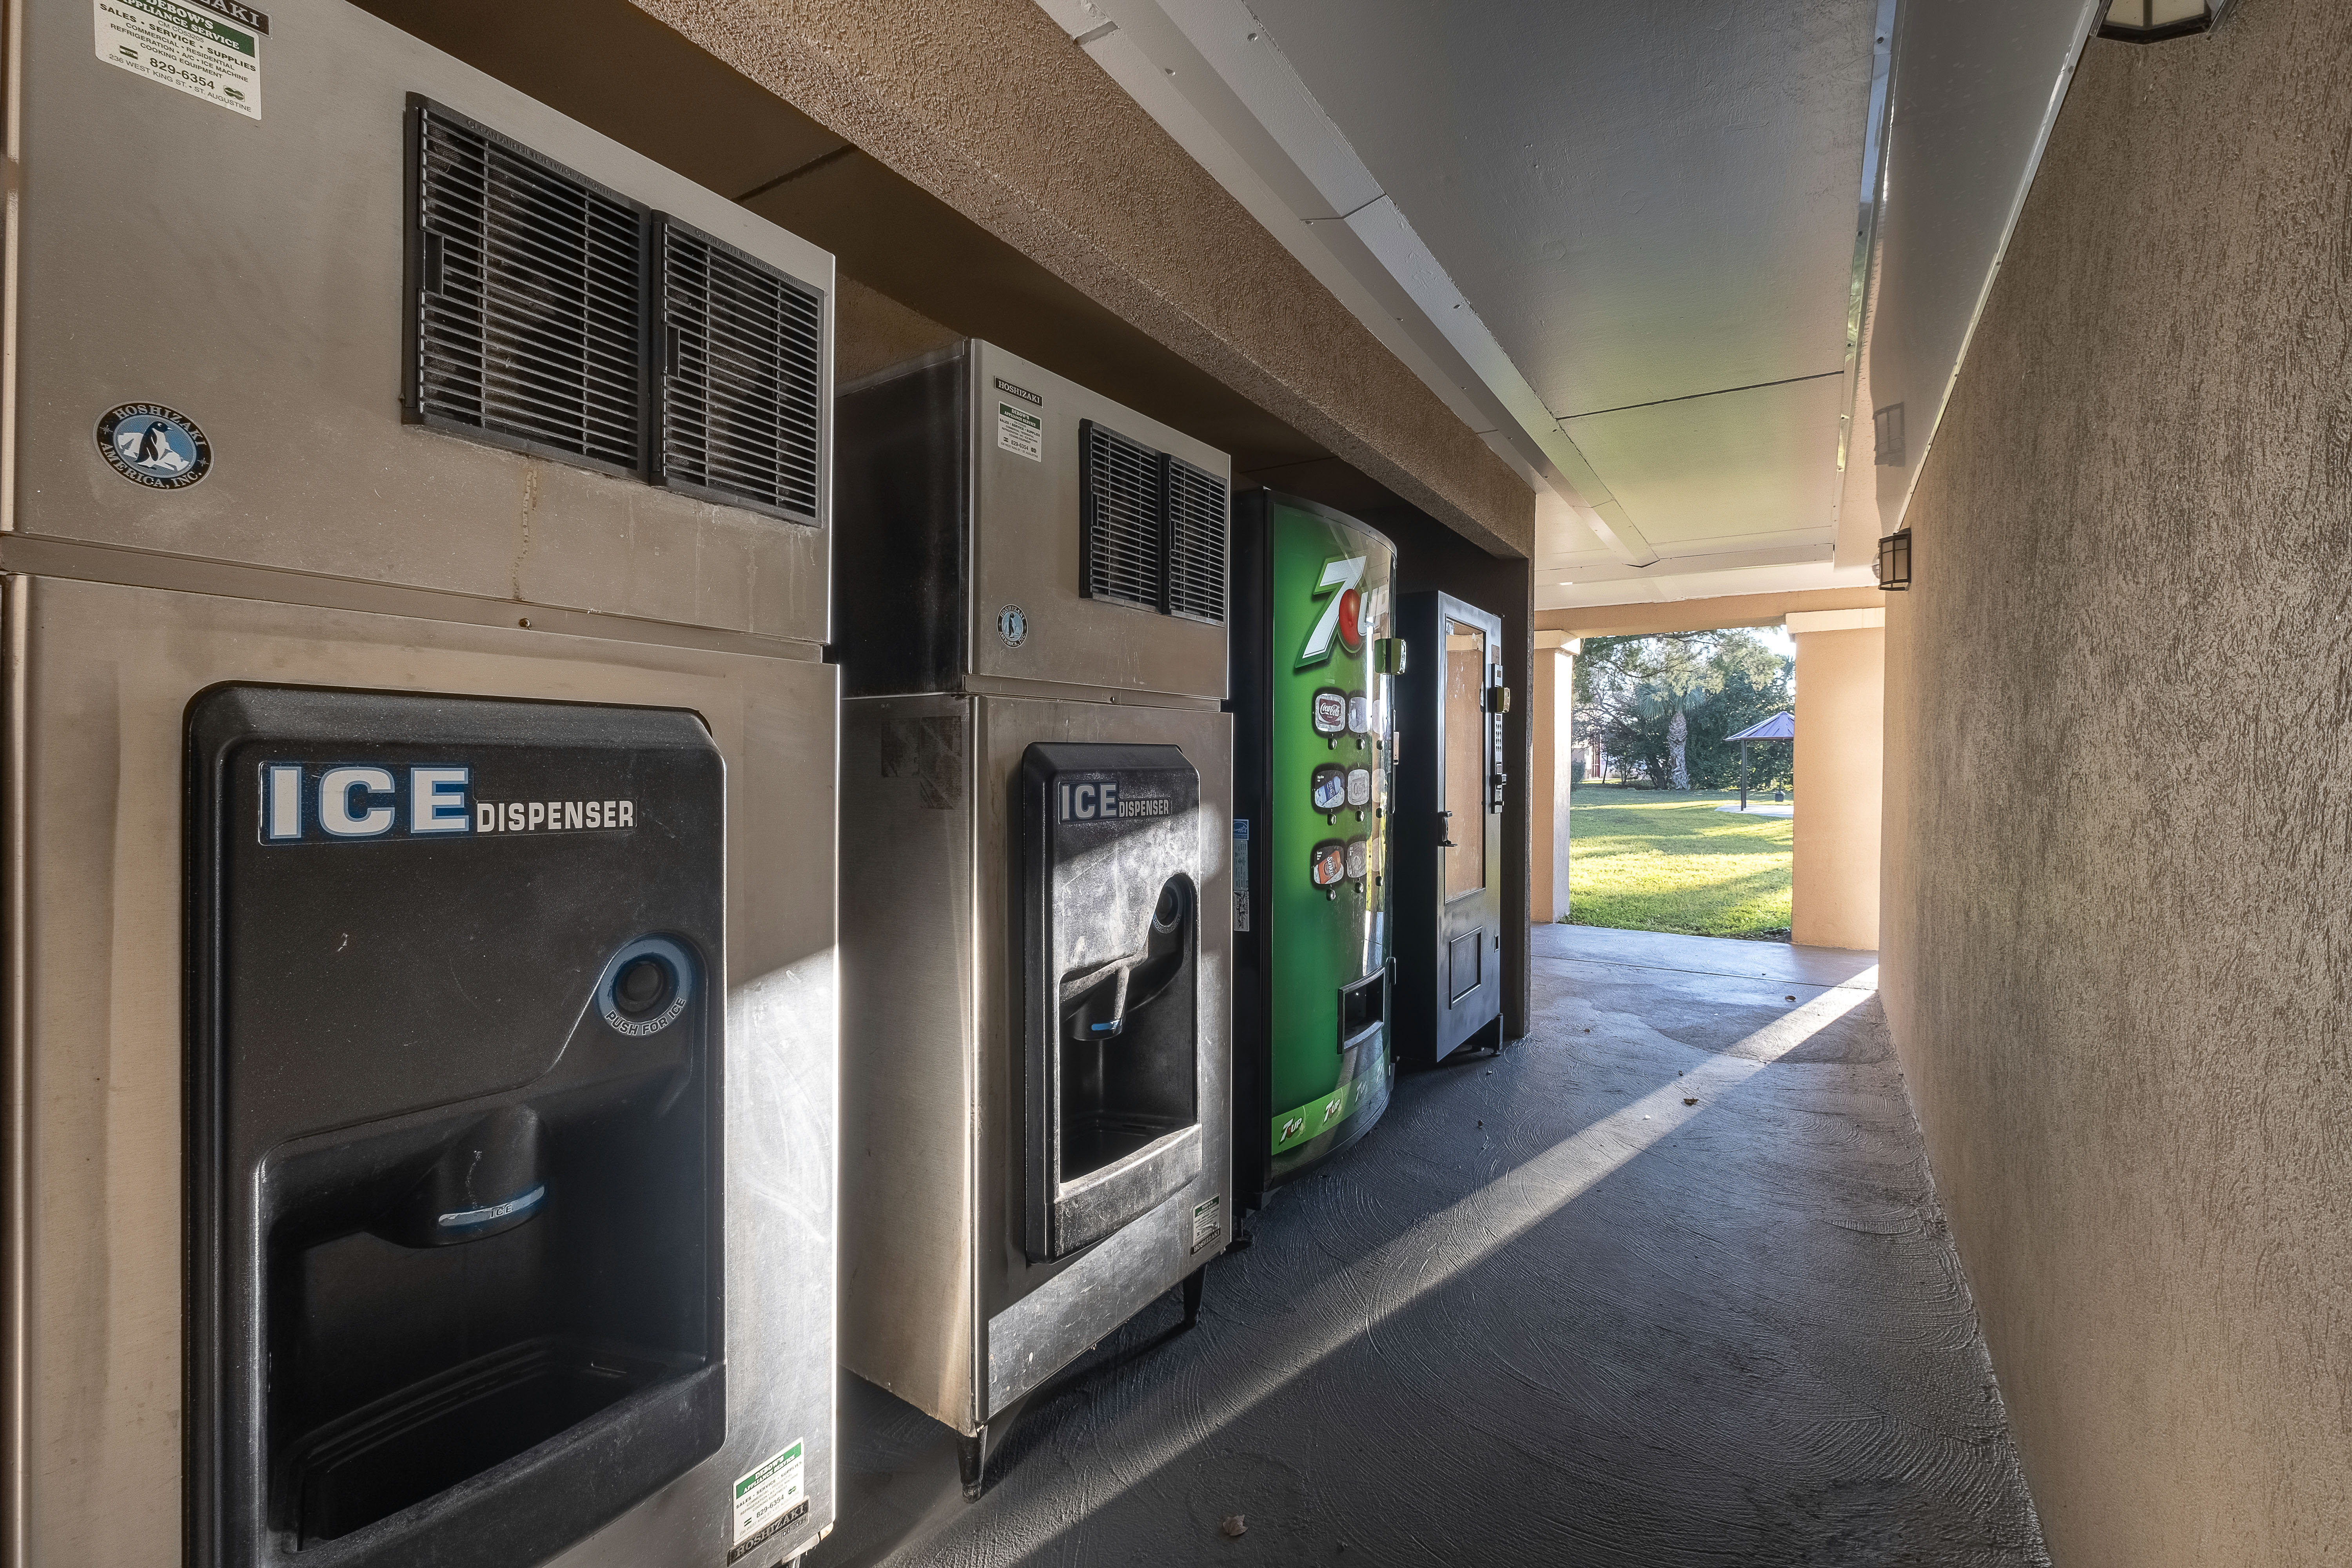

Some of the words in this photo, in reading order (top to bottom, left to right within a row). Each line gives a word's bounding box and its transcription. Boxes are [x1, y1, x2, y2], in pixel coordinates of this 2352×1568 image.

[100, 3, 137, 22] SALES
[149, 24, 196, 47] SERVICE
[207, 47, 256, 72] SUPPLIES
[158, 20, 170, 29] CM
[191, 24, 239, 49] SERVICE
[111, 23, 174, 53] REFRIGERATION
[182, 53, 194, 61] A/C
[201, 60, 214, 68] ICE
[216, 66, 249, 82] MACHINE
[126, 23, 179, 47] COMMERCIAL
[186, 47, 235, 70] RESIDENTIAL
[140, 43, 177, 60] COOKING
[180, 58, 223, 78] EQUIPMENT
[109, 54, 124, 63] 236
[125, 60, 151, 73] WEST
[153, 70, 173, 82] KING
[176, 79, 187, 88] ST.
[194, 86, 205, 94] ST.
[208, 92, 252, 112] AUGUSTINE
[150, 58, 215, 89] 829-6354
[998, 381, 1040, 403] HOSHIZAKI
[113, 405, 207, 446] HOSHIZAKI
[1004, 411, 1022, 421] APPLIANCE
[1023, 419, 1036, 427] SERVICE
[1011, 409, 1029, 420] DEBOW'S
[1011, 440, 1029, 450] 829-6354
[100, 442, 170, 489] AMERICA,
[171, 471, 202, 487] INC.
[1000, 606, 1025, 621] HOSHIZAKI
[269, 765, 469, 839] ICE
[476, 800, 634, 833] DISPENSER
[1062, 783, 1117, 820] ICE
[1119, 799, 1169, 817] DISPENSER
[604, 1010, 639, 1036] PUSH
[642, 1016, 668, 1035] FOR
[667, 997, 686, 1019] ICE
[1323, 1098, 1340, 1123] 7UP
[1279, 1117, 1302, 1143] 7UP
[490, 1204, 513, 1219] ICE
[1194, 1230, 1220, 1252] HOSHIZAKI
[736, 1497, 751, 1509] SALES
[757, 1479, 776, 1494] SERVICE
[757, 1494, 784, 1518] 829-6354
[736, 1504, 804, 1556] HOSHIZAKI
